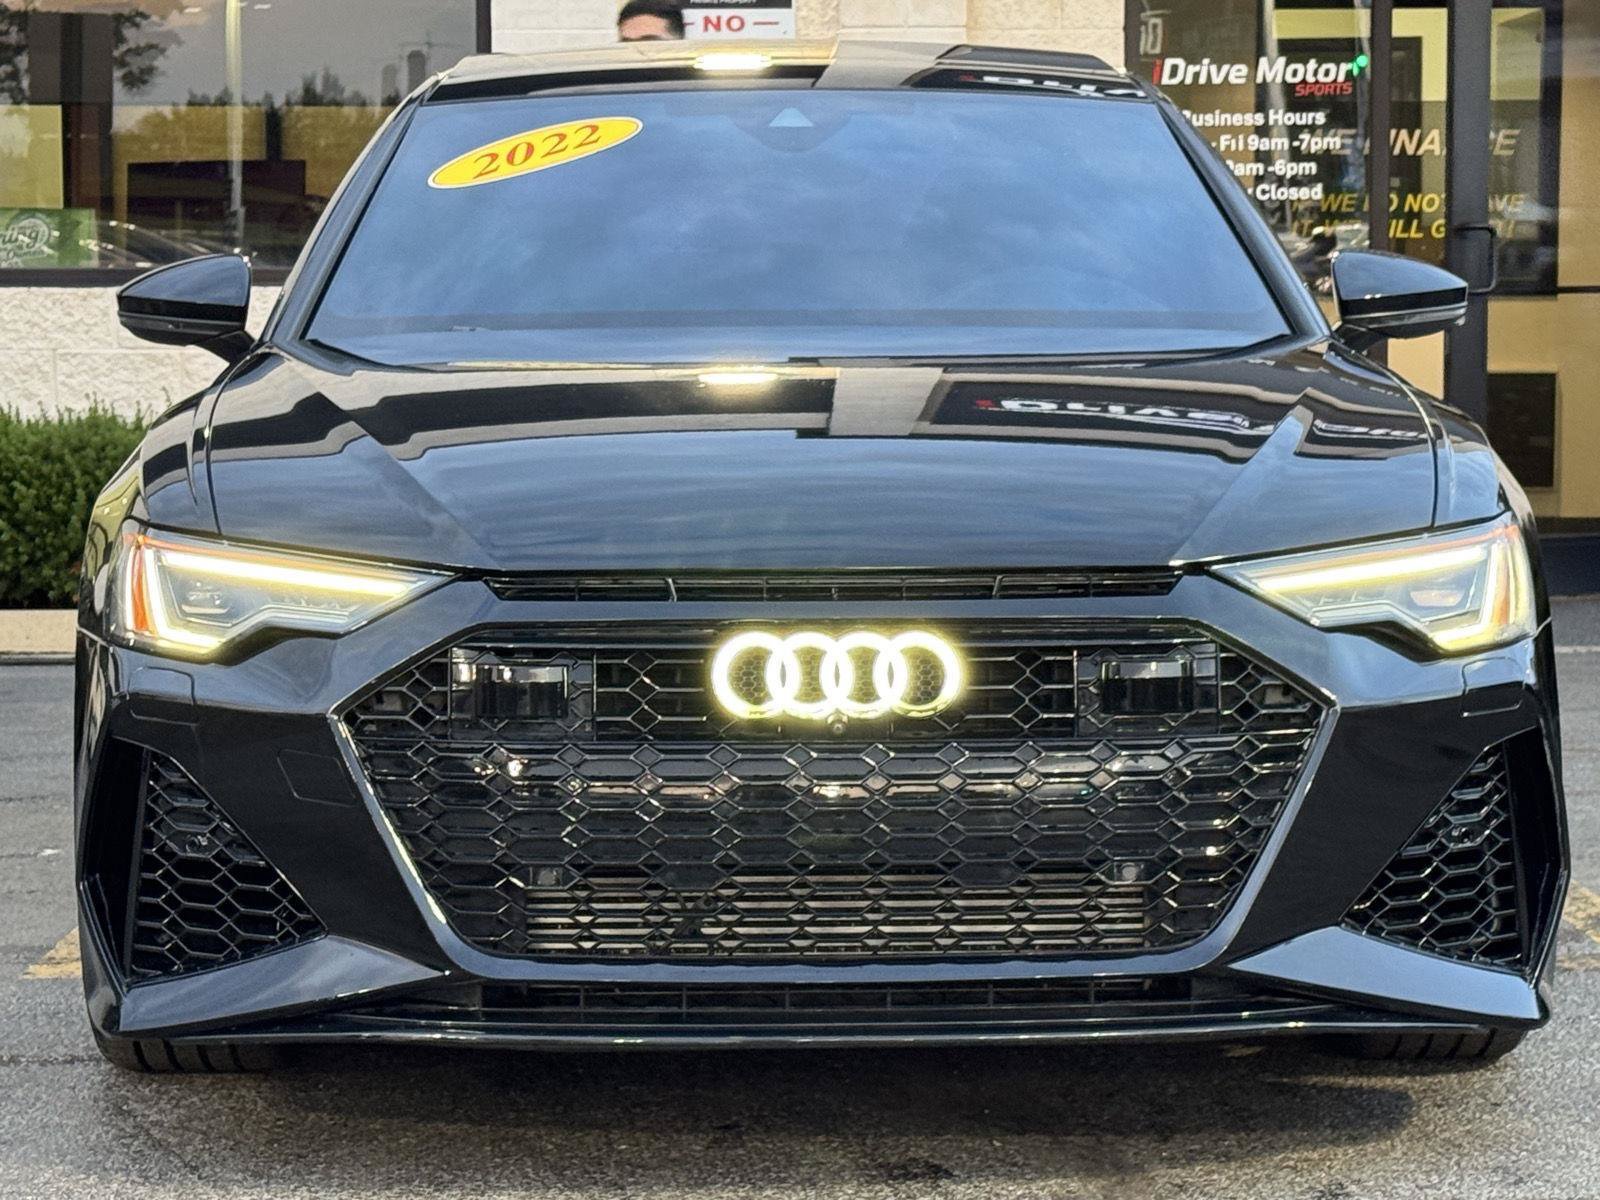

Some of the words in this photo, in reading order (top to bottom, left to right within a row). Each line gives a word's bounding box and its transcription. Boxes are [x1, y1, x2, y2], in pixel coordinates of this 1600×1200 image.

[703, 15, 746, 33] NO
[1152, 57, 1249, 86] iDrive
[1255, 56, 1354, 85] Motor
[1294, 82, 1353, 97] SPORTS
[1268, 109, 1327, 127] Hours
[473, 124, 601, 180] 2022
[1219, 134, 1244, 152] Fri
[1248, 134, 1289, 151] 9am
[1256, 183, 1323, 201] Closed
[1404, 193, 1446, 213] NO
[1389, 219, 1424, 239] ILL
